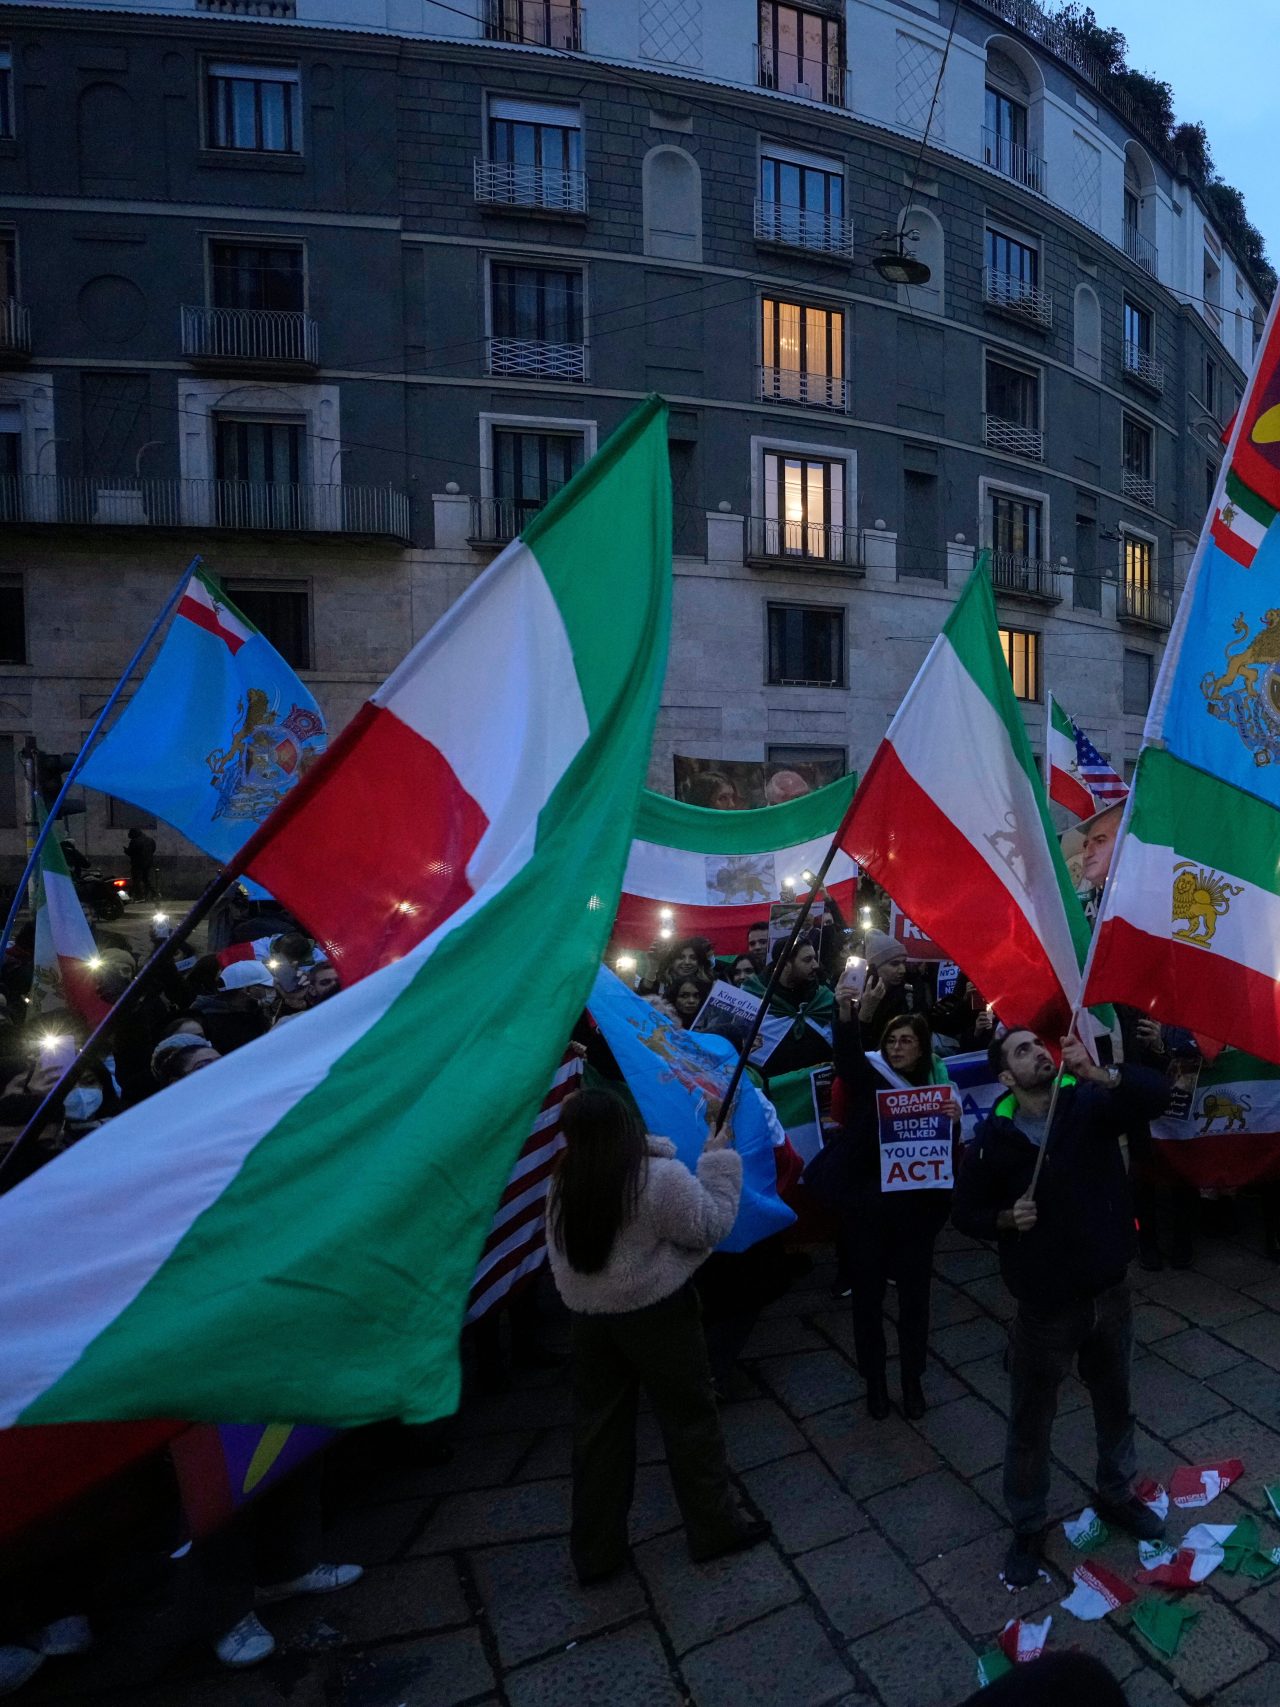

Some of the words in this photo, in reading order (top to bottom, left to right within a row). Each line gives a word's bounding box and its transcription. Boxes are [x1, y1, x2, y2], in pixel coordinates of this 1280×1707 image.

[710, 998, 731, 1011] Reza
[717, 990, 736, 1005] King
[737, 999, 747, 1007] of
[886, 1090, 943, 1107] OBAMA
[890, 1103, 940, 1115] WATCHED
[893, 1116, 939, 1131] BIDEN
[898, 1129, 937, 1139] TALKED
[885, 1146, 916, 1159] YOU
[919, 1145, 949, 1157] CAN
[886, 1159, 949, 1185] ACT.
